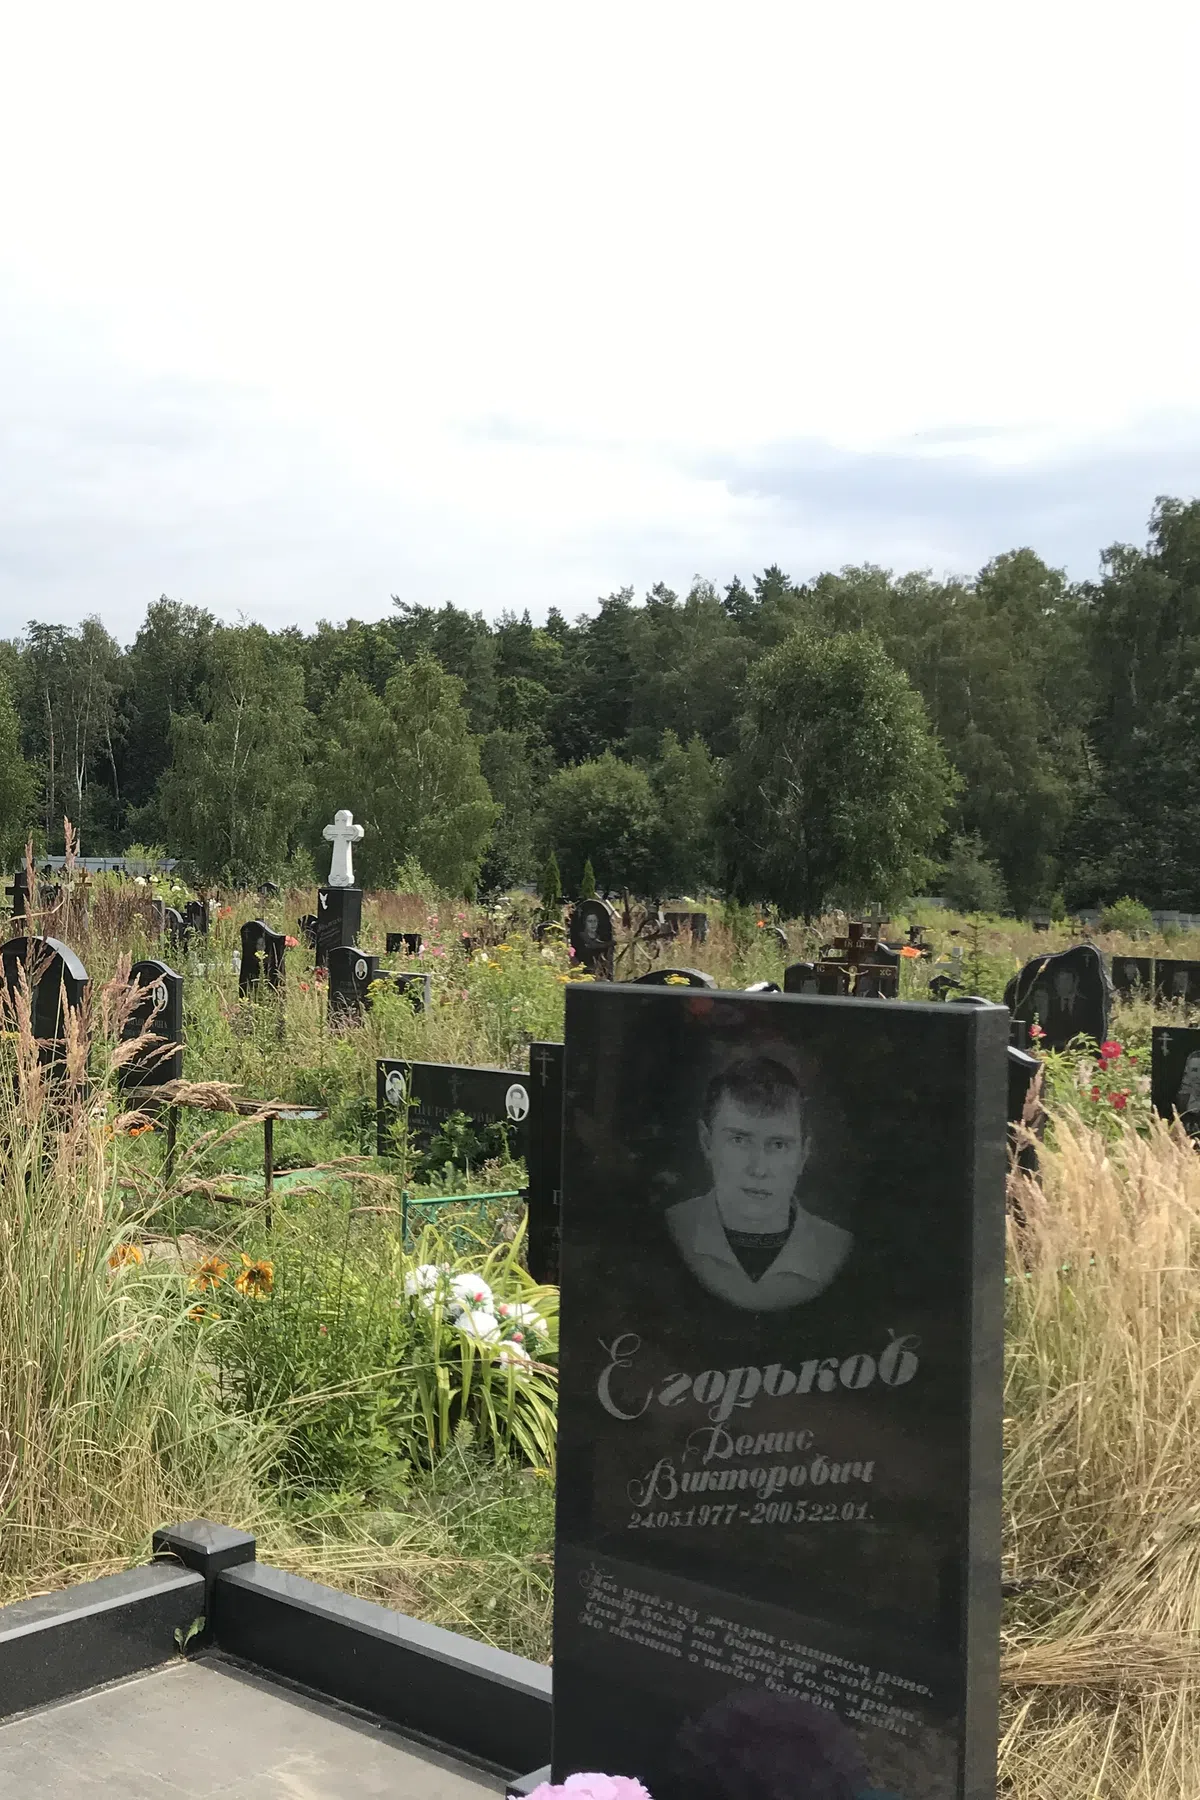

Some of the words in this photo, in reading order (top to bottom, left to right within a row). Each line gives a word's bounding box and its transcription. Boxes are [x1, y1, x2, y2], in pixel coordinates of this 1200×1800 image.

[598, 1328, 921, 1422] Егорьков
[681, 1422, 814, 1465] Денис
[628, 1455, 875, 1507] Викторович
[687, 1652, 699, 1663] о
[704, 1657, 756, 1683] тебе
[779, 1639, 870, 1676] слишком
